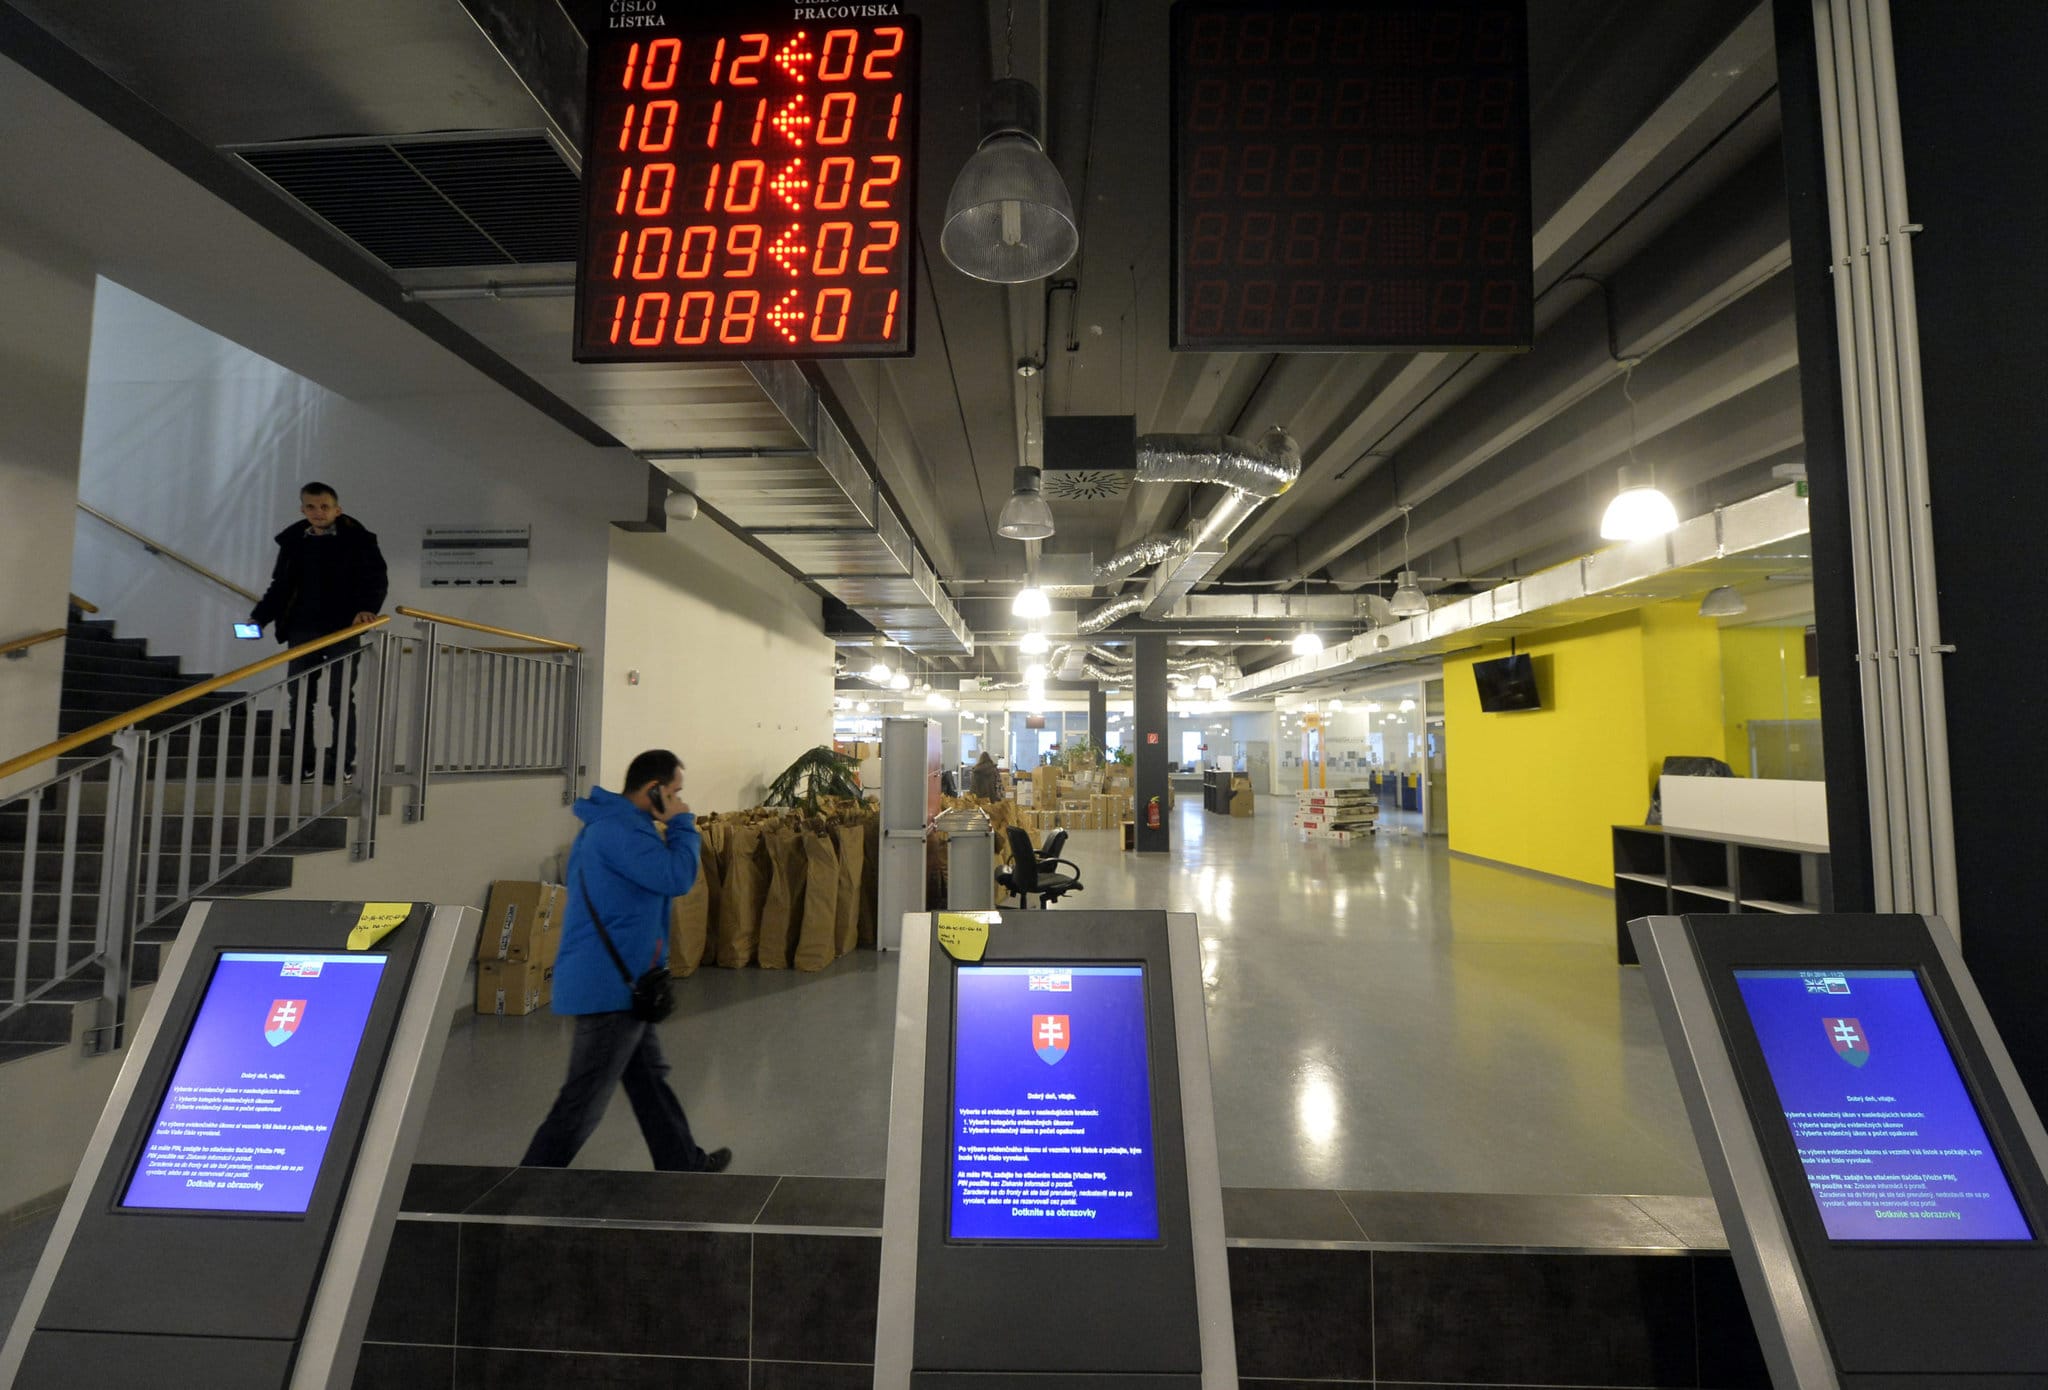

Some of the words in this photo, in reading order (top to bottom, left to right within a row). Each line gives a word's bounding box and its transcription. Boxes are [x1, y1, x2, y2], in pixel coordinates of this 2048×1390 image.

[609, 14, 666, 28] LÍSTKA
[794, 4, 899, 20] PRACOVISKA
[818, 27, 904, 81] 02
[816, 92, 902, 146] 01
[814, 155, 901, 211] 02
[613, 224, 766, 280] 1009
[812, 221, 899, 276] 02
[610, 290, 764, 346] 1008
[810, 288, 898, 342] 01
